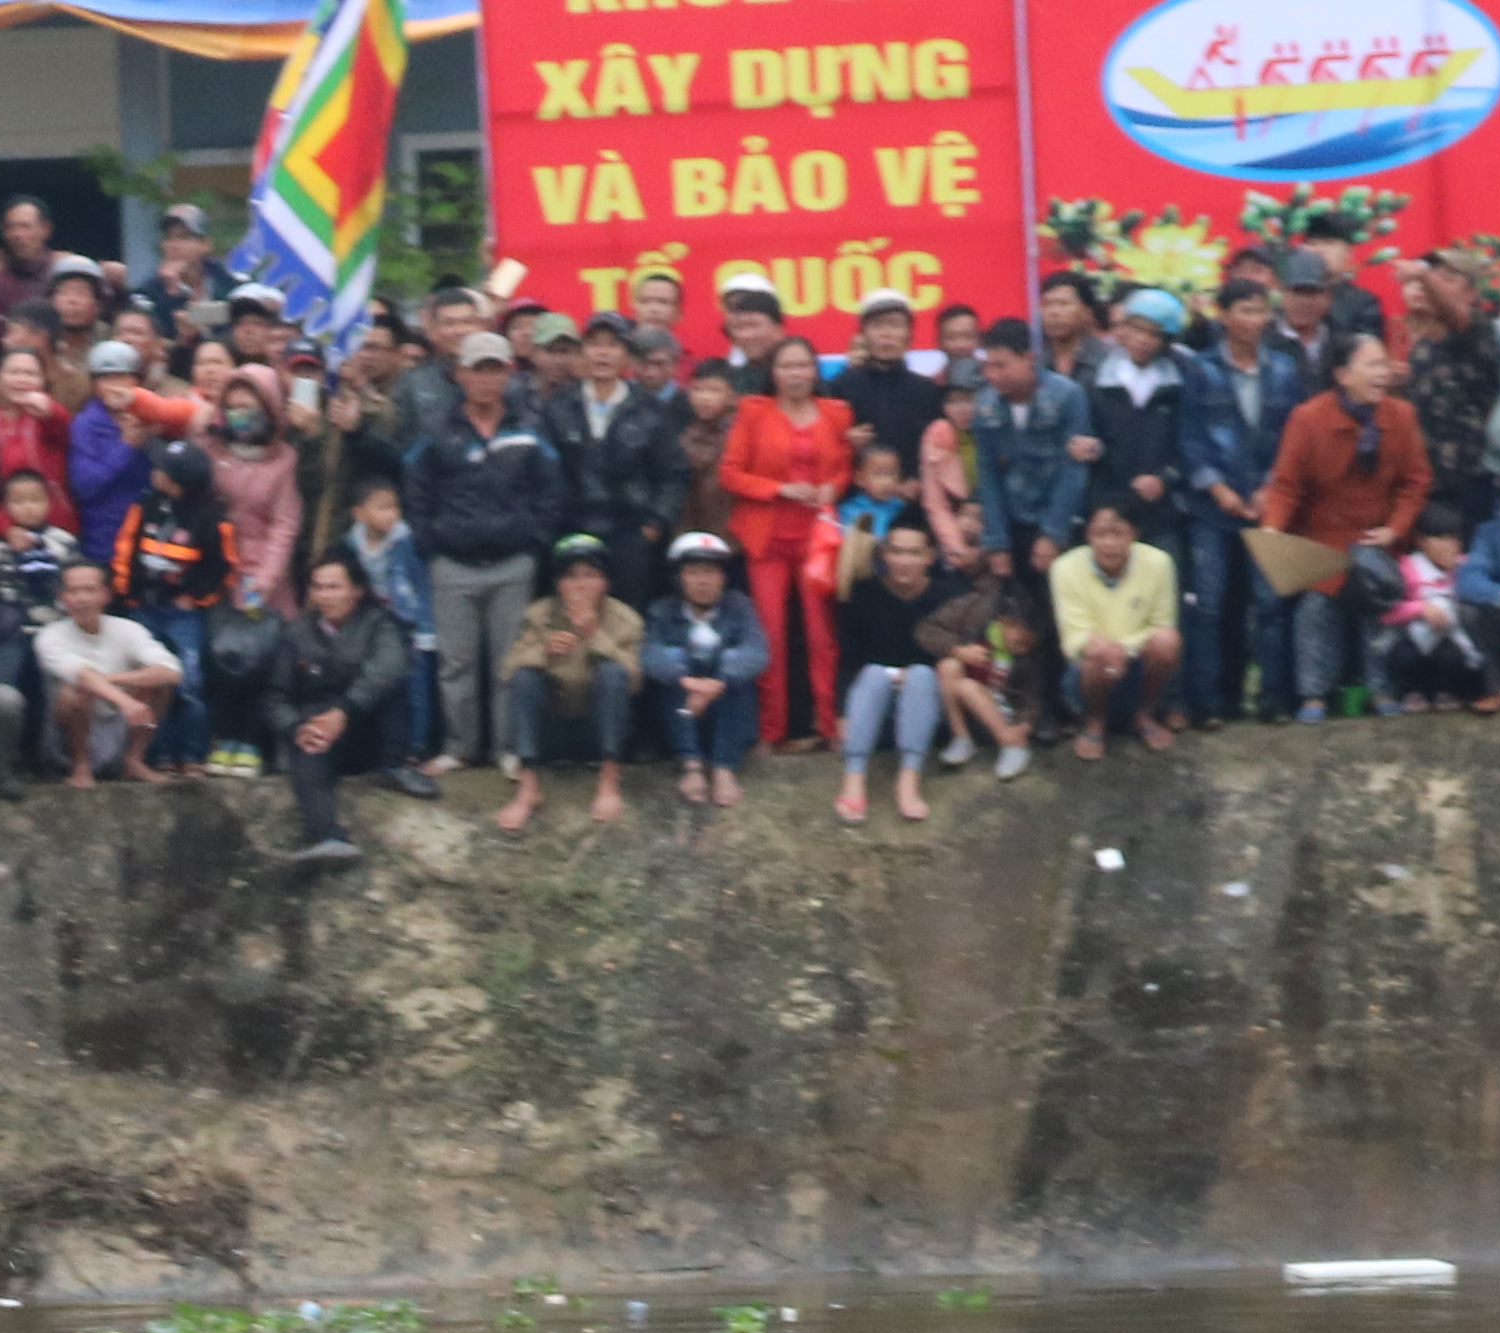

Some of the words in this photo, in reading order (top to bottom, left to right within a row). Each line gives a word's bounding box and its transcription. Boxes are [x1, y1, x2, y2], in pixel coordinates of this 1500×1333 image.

[534, 43, 701, 120] XÂY
[728, 38, 971, 118] DỰNG
[531, 149, 646, 225] VÀ
[671, 135, 848, 217] BẢO
[874, 130, 982, 217] VỆ
